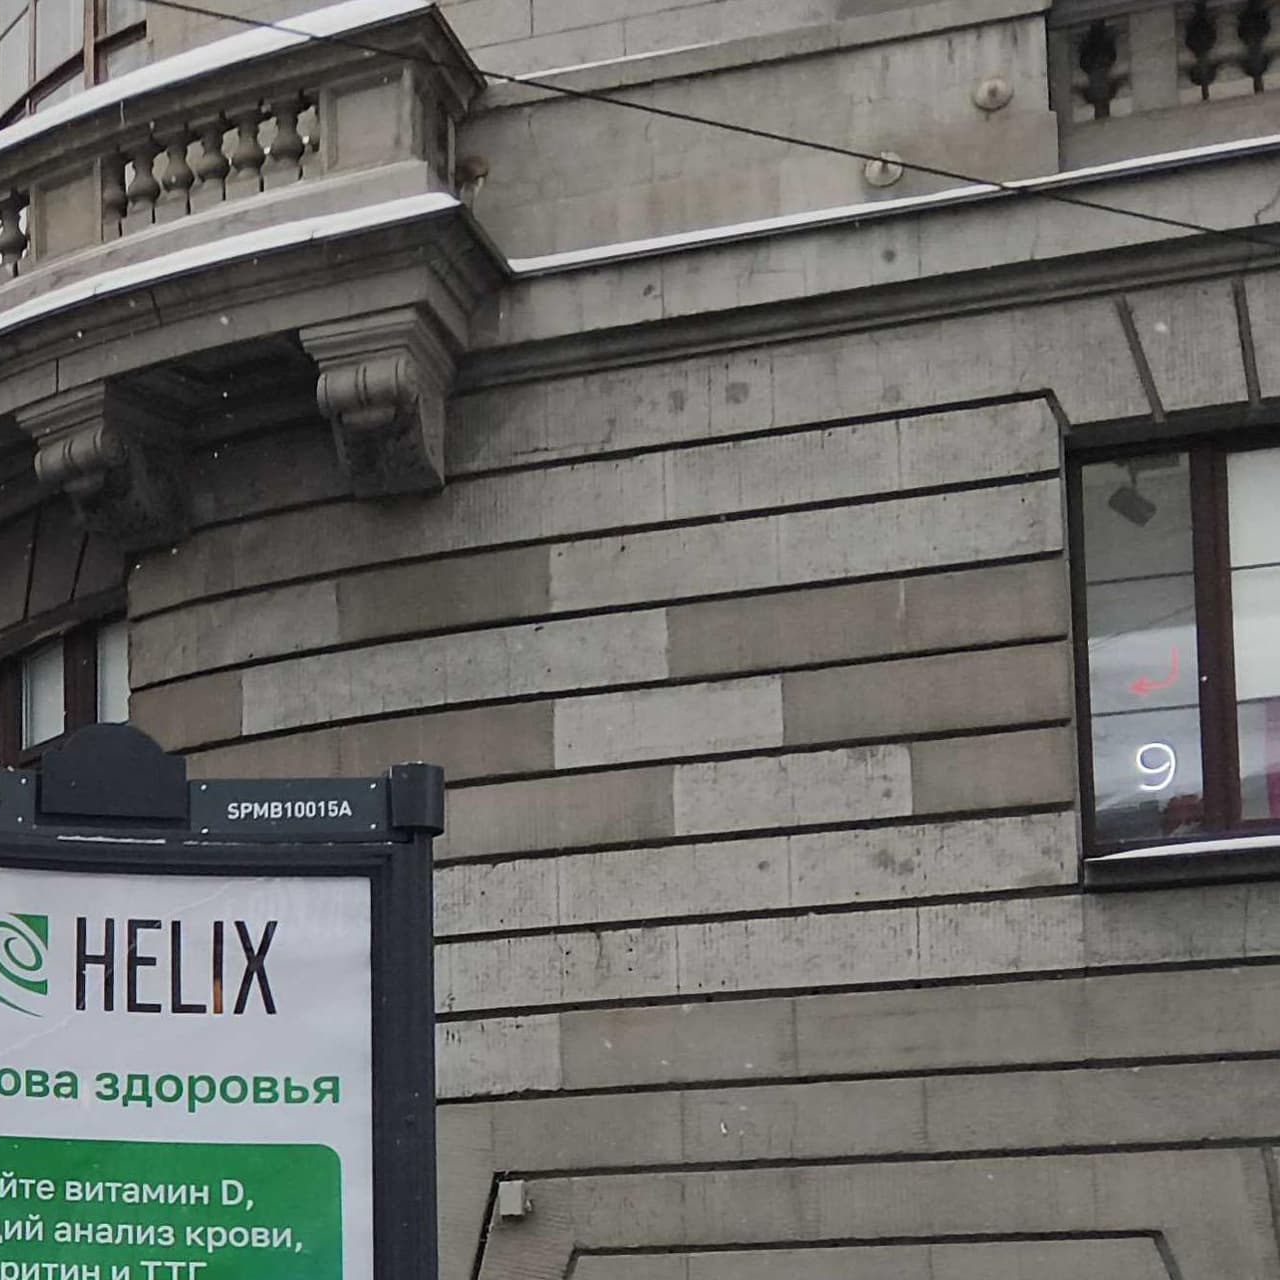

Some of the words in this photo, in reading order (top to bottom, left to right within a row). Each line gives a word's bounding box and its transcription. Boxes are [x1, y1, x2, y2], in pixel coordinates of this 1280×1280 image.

[227, 800, 352, 821] SPMB10015A
[75, 917, 278, 1015] HELIX
[95, 1071, 342, 1113] здоровья
[65, 1180, 209, 1206] витамин
[221, 1179, 254, 1211] D,
[54, 1220, 175, 1246] анализ
[186, 1225, 303, 1253] крови,
